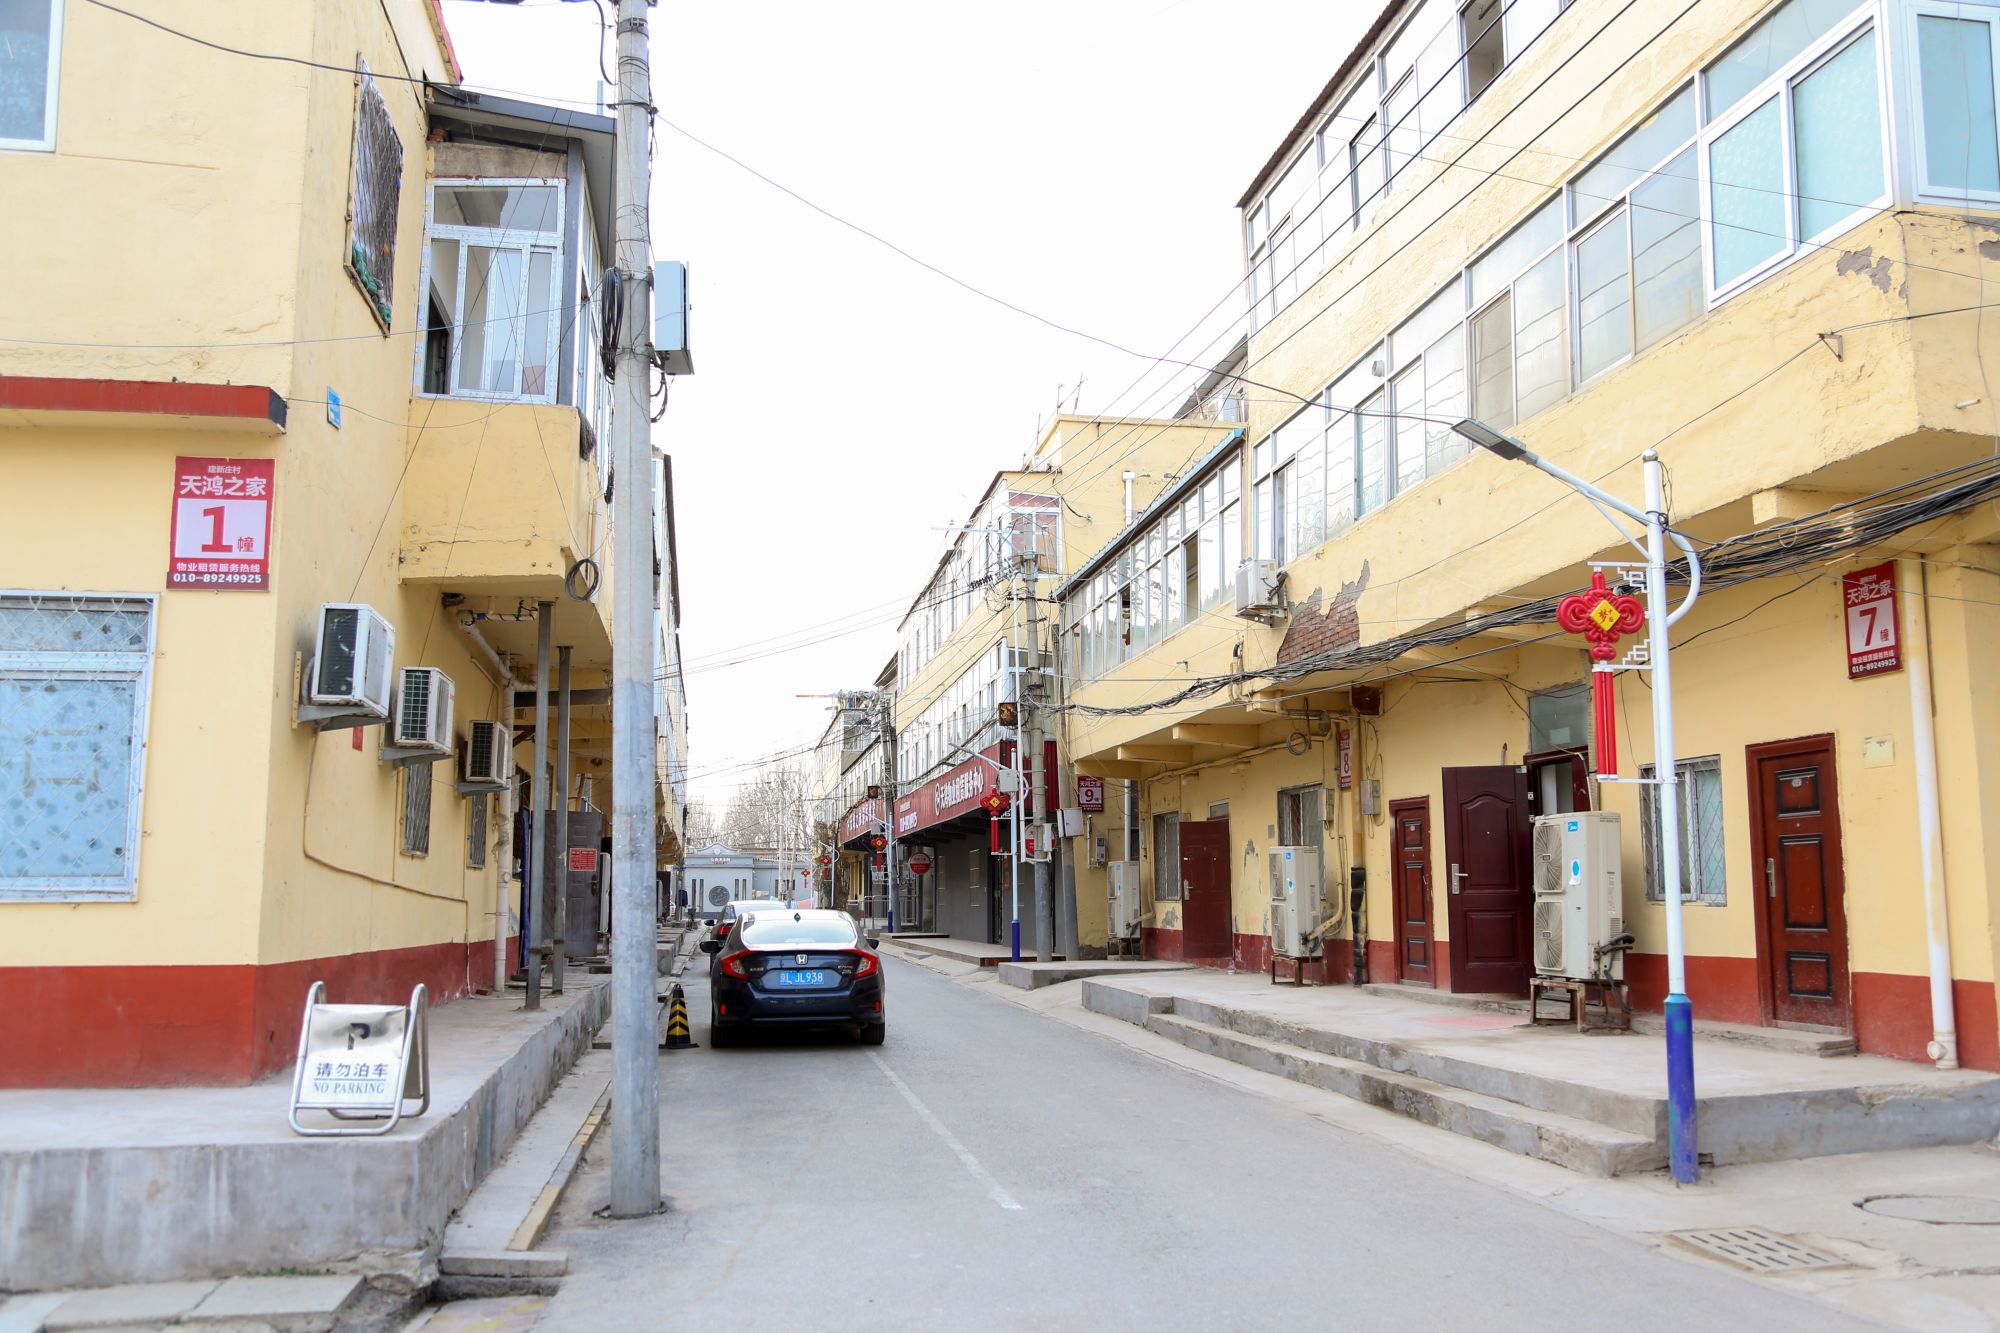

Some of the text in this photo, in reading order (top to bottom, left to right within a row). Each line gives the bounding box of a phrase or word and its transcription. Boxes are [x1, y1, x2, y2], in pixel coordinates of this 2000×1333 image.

[180, 475, 267, 496] 天鸿之家
[176, 562, 261, 573] 物业租赁服务热线
[173, 573, 262, 583] 010-89249925
[1847, 580, 1892, 605] 天鸿之家
[1084, 789, 1094, 802] 9
[315, 1062, 388, 1078] 请勿泊车
[312, 1082, 385, 1094] NO PARKING
